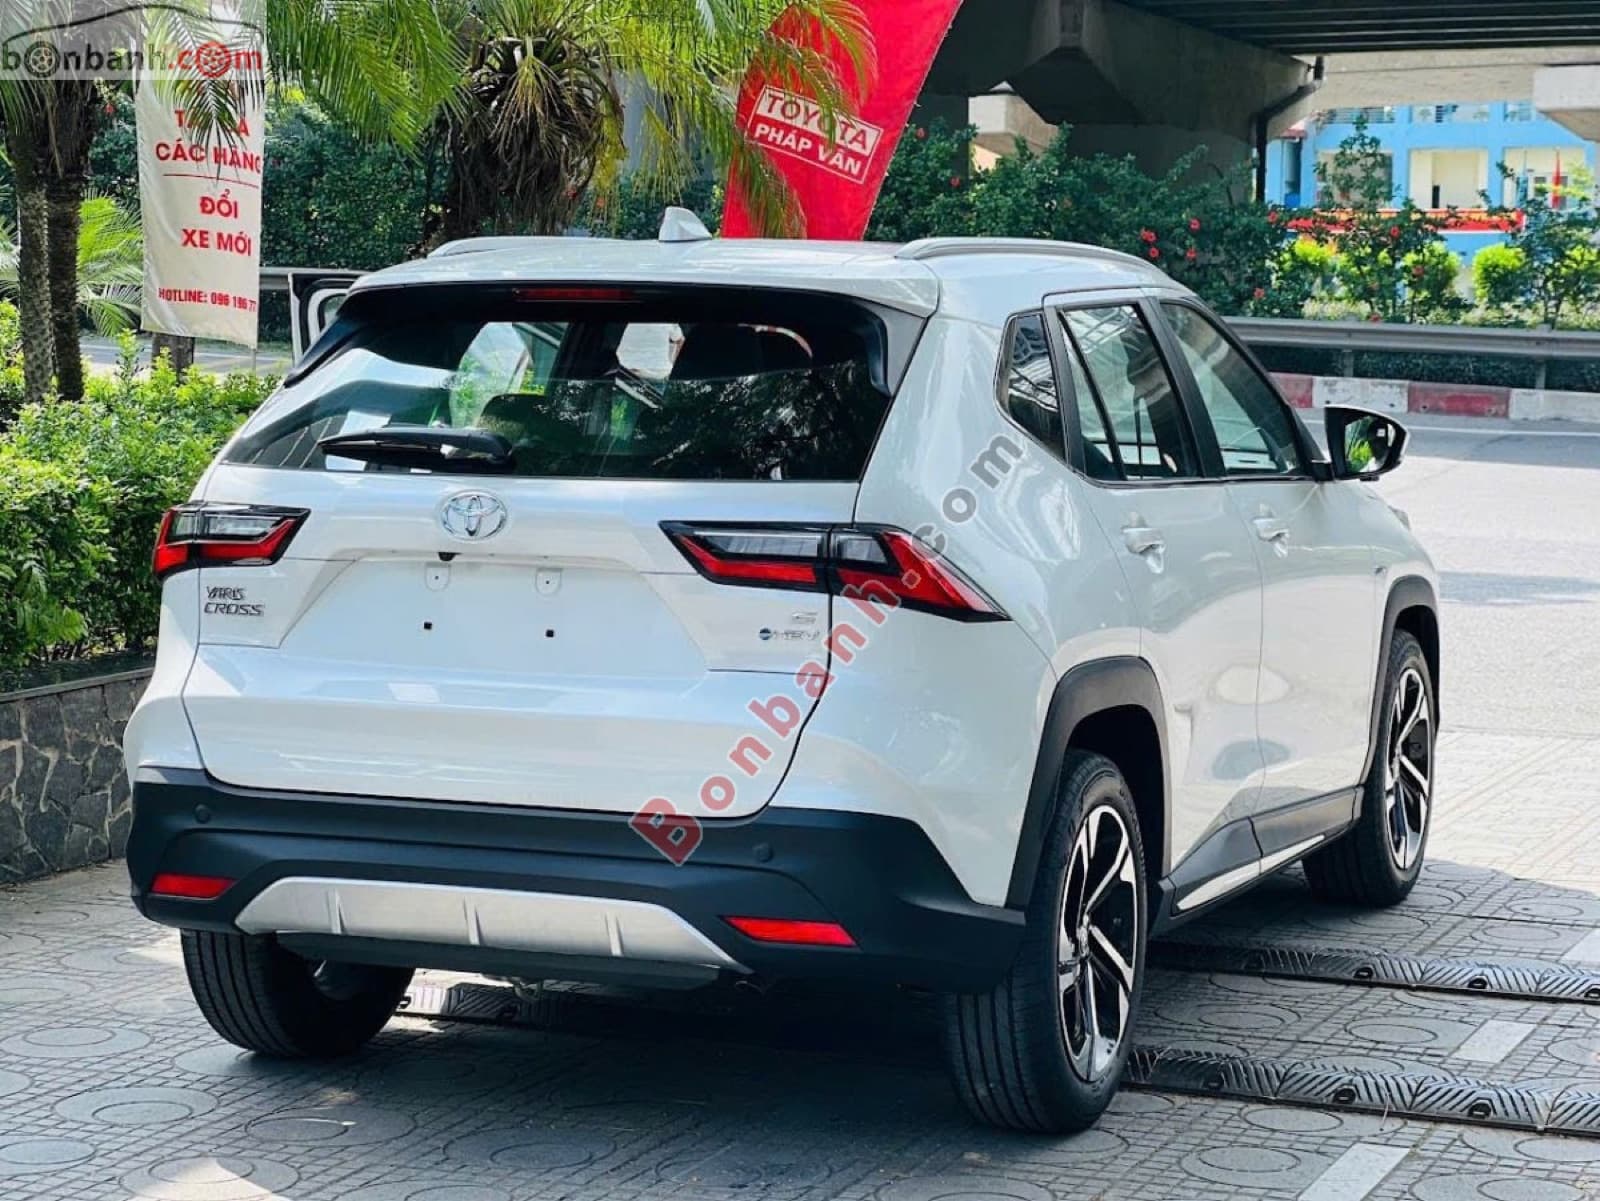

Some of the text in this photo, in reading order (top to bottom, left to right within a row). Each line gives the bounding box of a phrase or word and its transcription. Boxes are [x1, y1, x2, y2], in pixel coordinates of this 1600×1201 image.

[156, 138, 206, 162] CÁC
[754, 123, 813, 153] PHÁP
[200, 188, 239, 219] ĐỔI
[182, 228, 252, 256] XE MỚI
[158, 286, 208, 304] HOTLINE:
[206, 585, 246, 600] YARIS
[203, 602, 265, 617] CROSS
